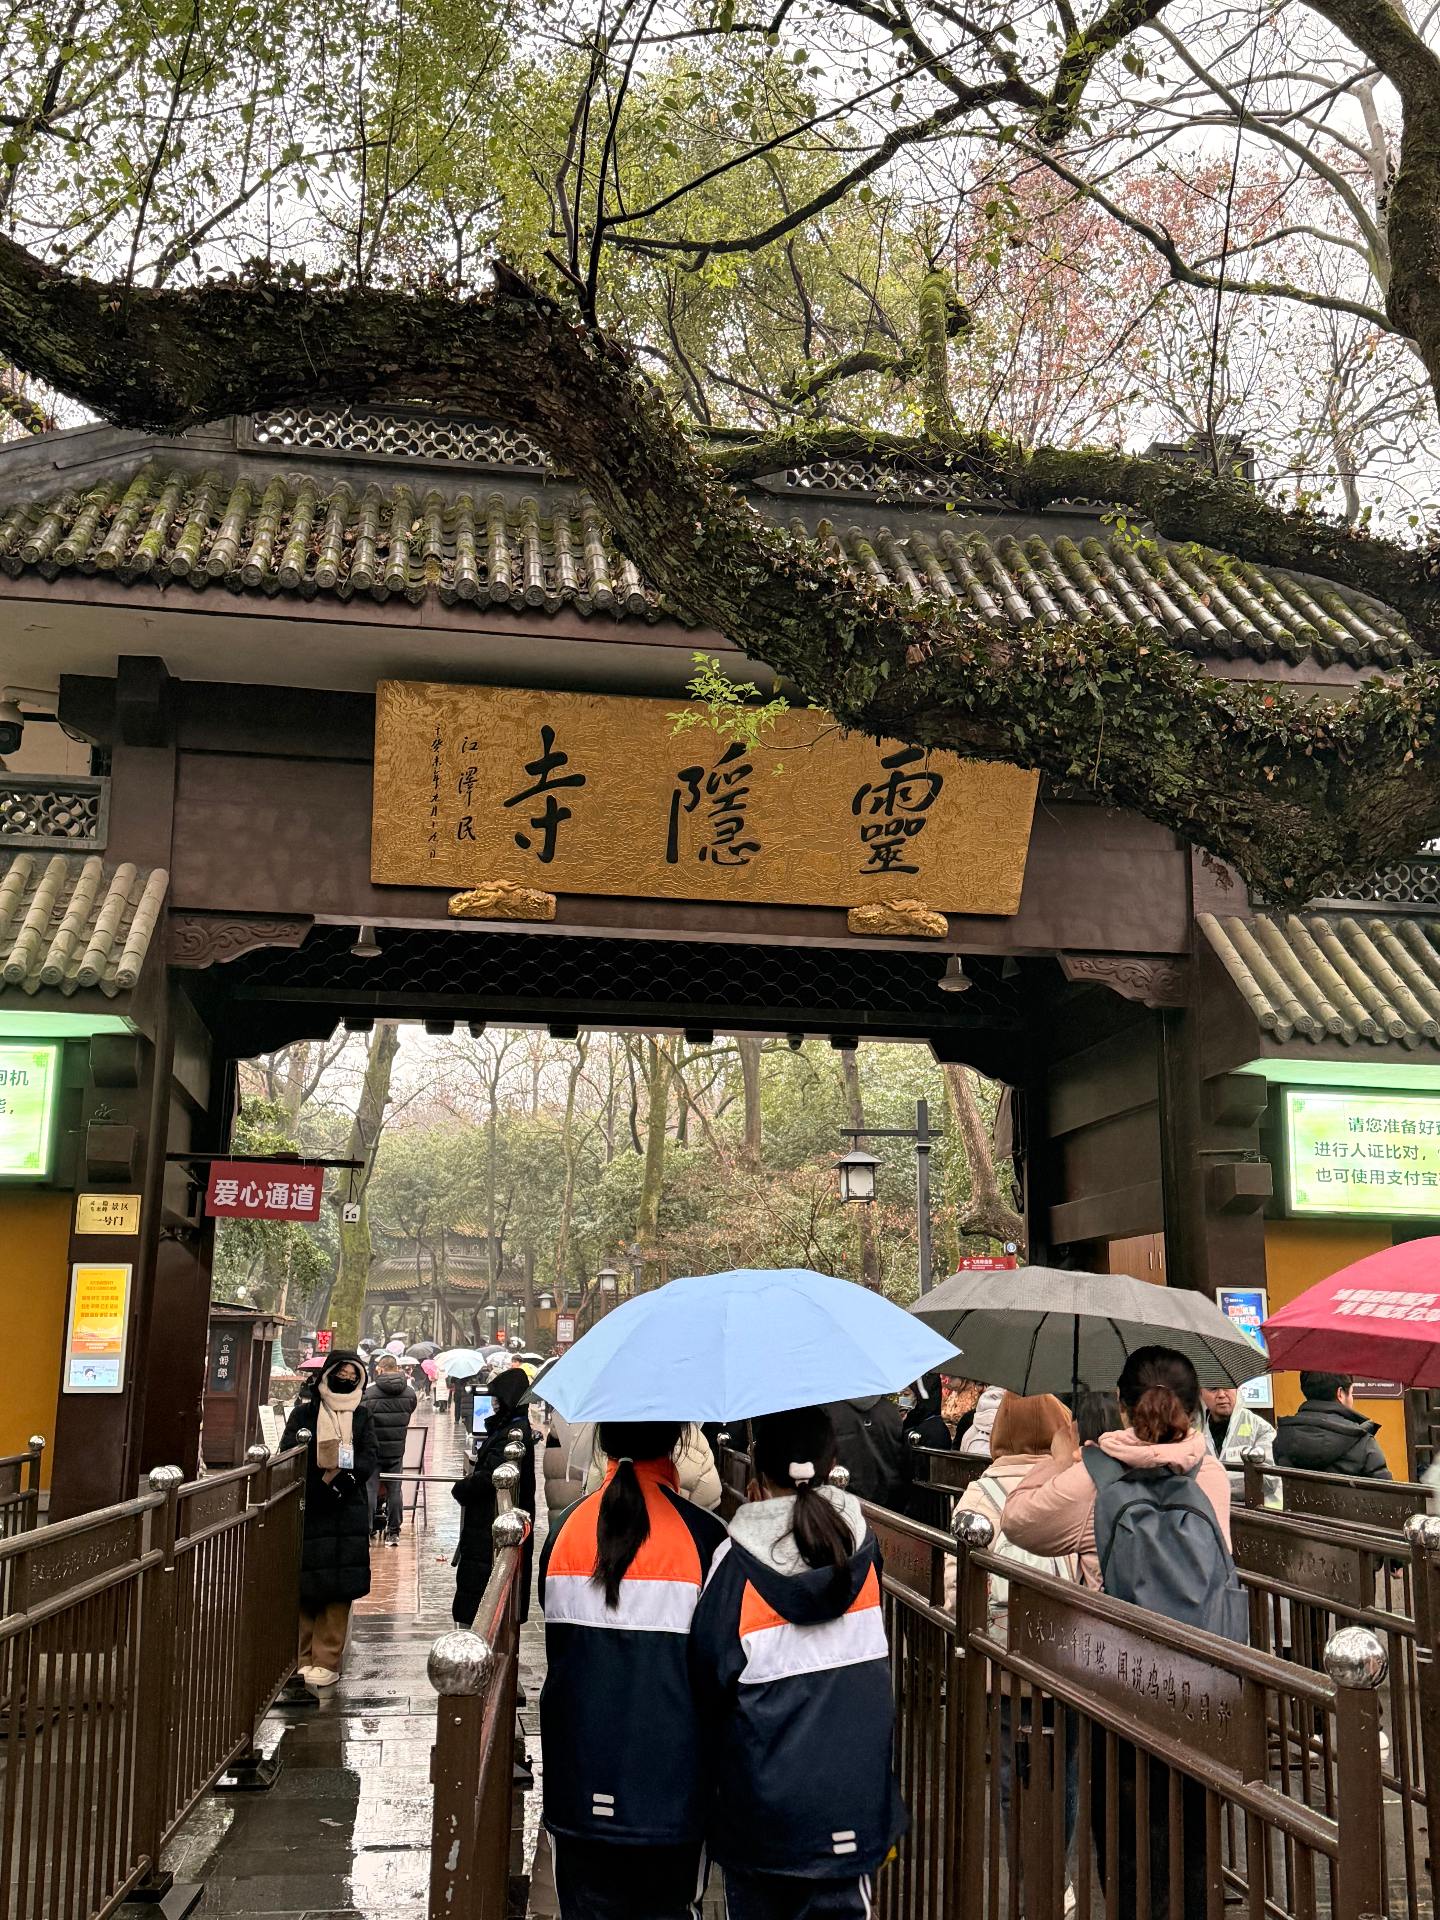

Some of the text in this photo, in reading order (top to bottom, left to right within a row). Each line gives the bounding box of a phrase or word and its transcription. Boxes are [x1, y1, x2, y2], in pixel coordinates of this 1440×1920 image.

[457, 736, 479, 841] 江澤民
[1314, 1141, 1440, 1160] 进行人证比对，
[1316, 1167, 1440, 1186] 也可使用支付宝
[213, 1179, 316, 1211] 爱心通道
